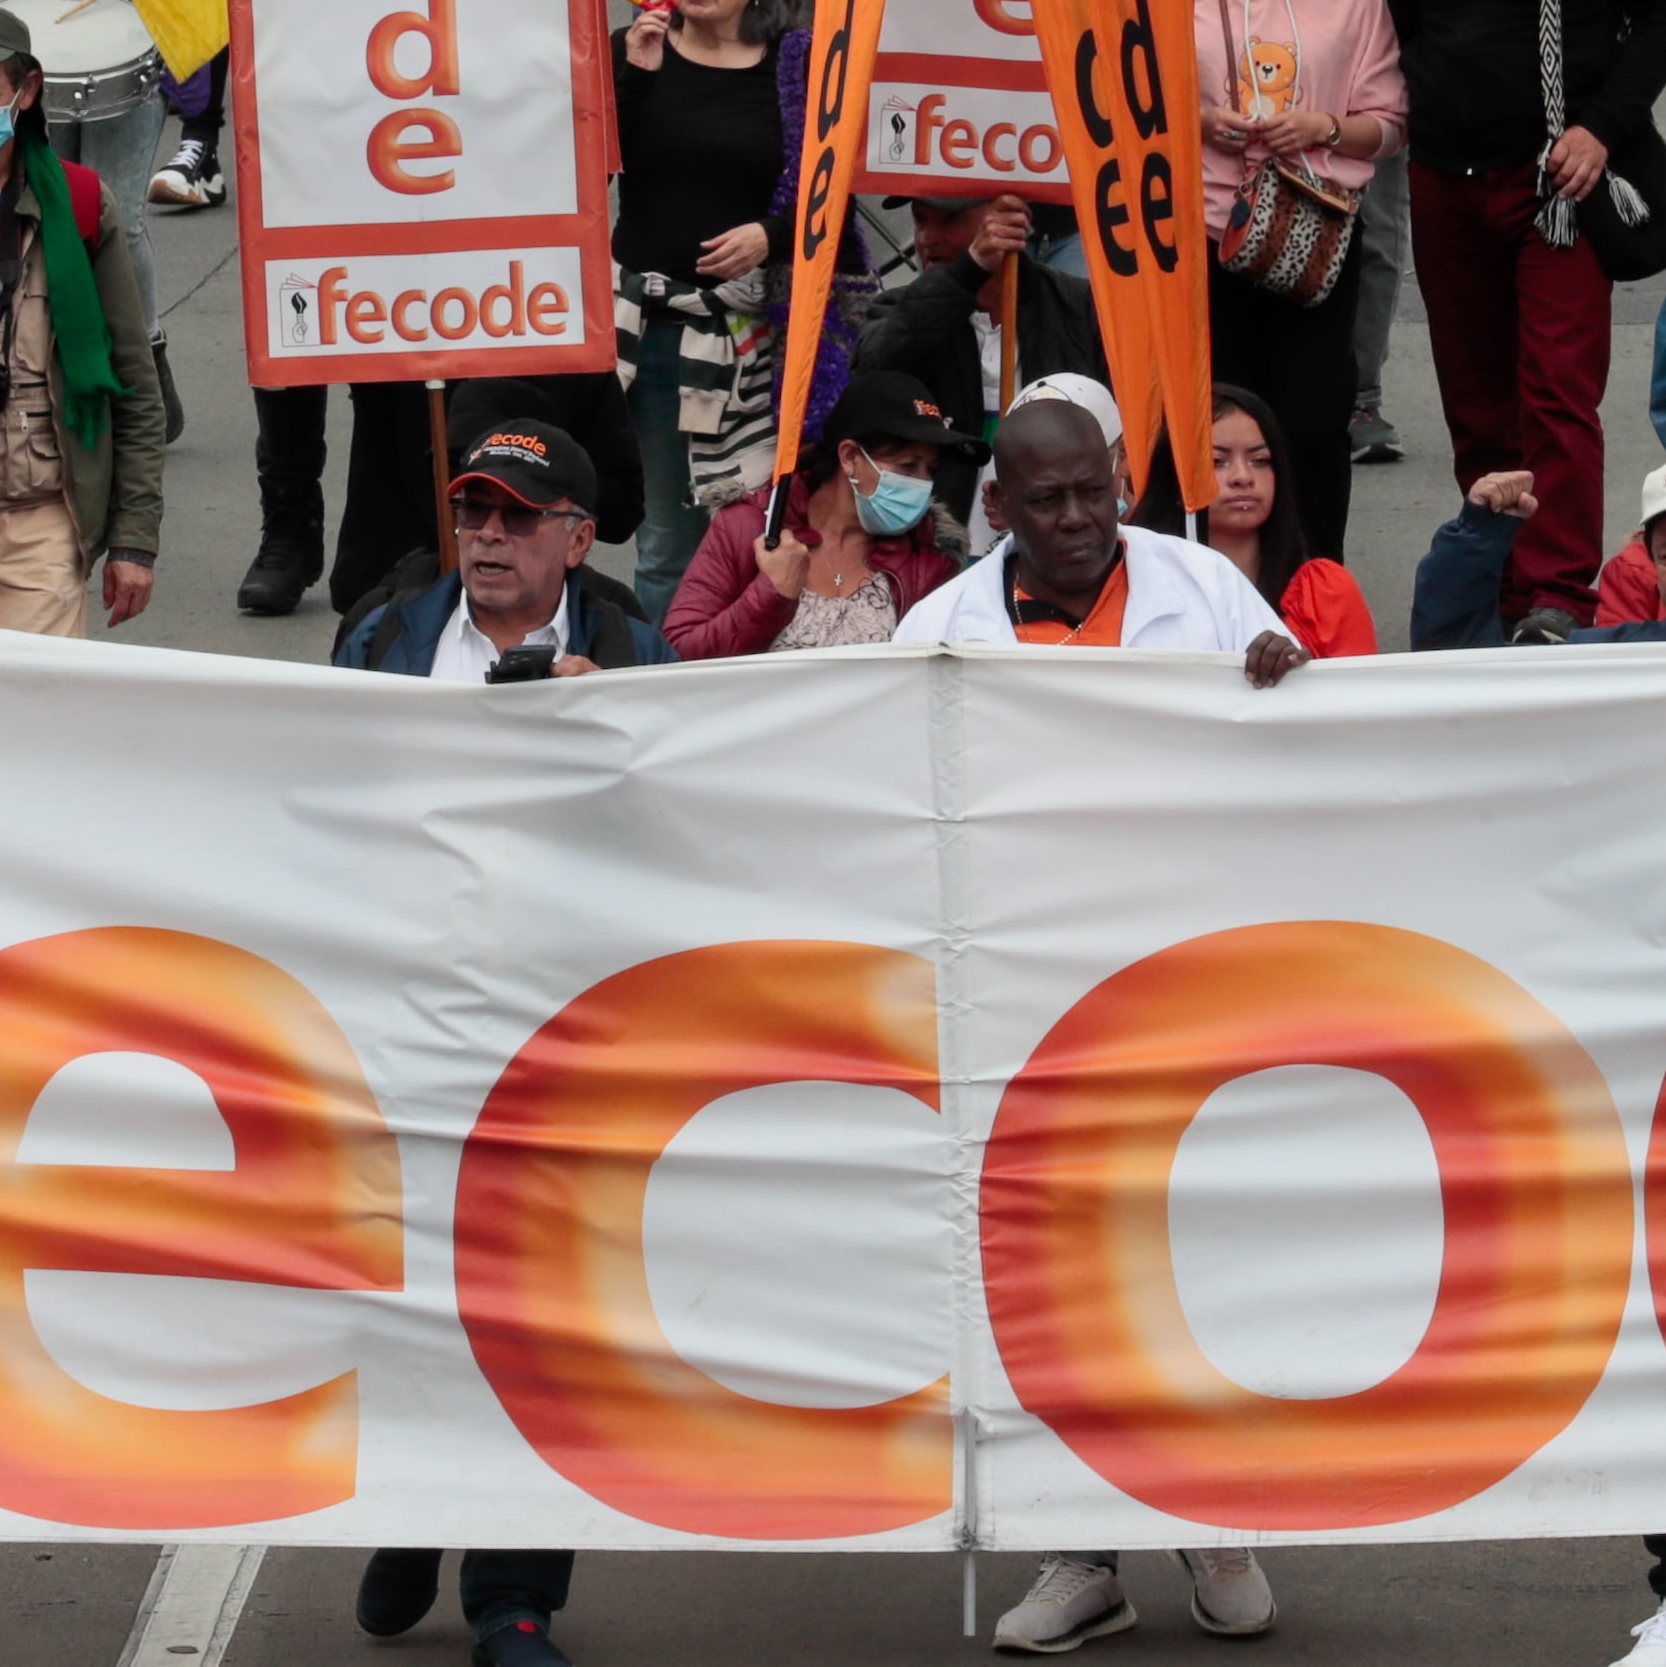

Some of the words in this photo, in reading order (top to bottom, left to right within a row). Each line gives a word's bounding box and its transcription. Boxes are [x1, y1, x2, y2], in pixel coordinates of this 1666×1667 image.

[914, 95, 1065, 175] feco
[319, 260, 569, 345] fecode
[483, 432, 547, 457] ecode
